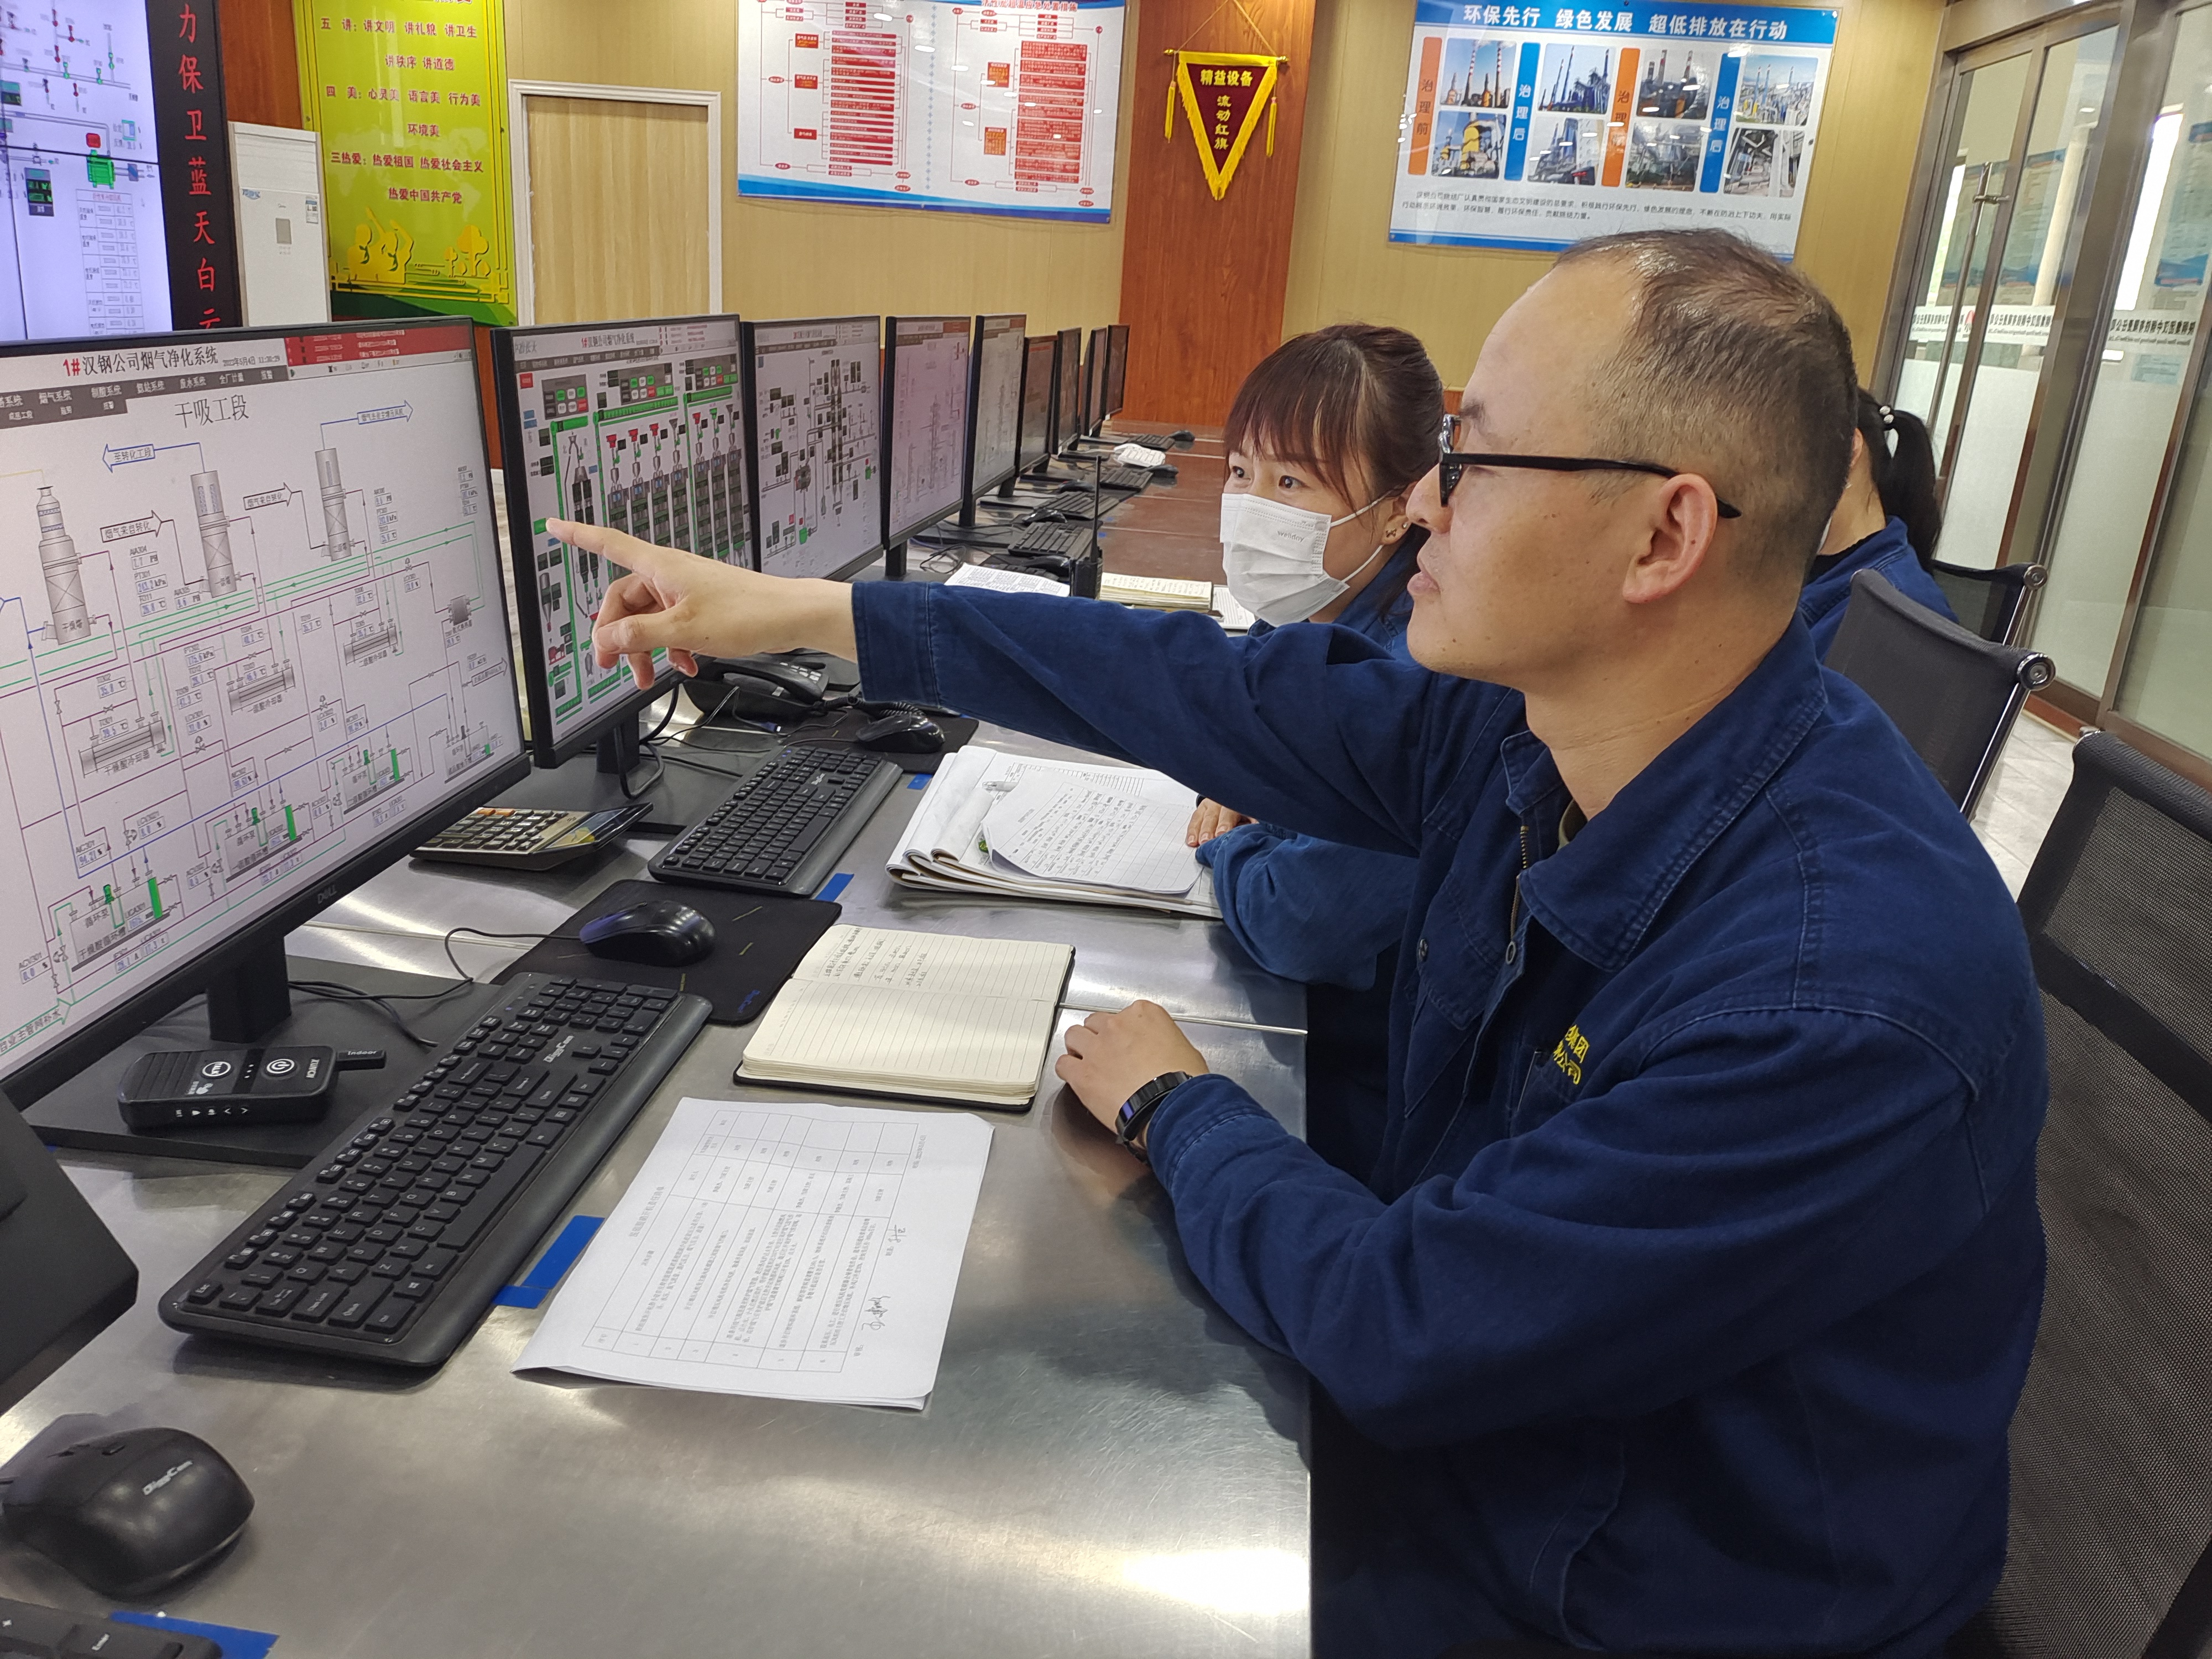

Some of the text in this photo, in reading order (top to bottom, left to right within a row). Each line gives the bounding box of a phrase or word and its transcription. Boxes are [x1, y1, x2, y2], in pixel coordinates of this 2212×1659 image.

[321, 18, 331, 29] 五
[404, 22, 437, 35] 讲礼貌
[445, 23, 478, 38] 讲卫生
[1463, 4, 1788, 40] 环保先行 绿色发展 超低排放在行动
[385, 54, 455, 70] 讲秩序 讲道德
[326, 86, 336, 97] 四
[409, 90, 440, 103] 语言美
[448, 92, 481, 106] 行为美
[1416, 79, 1433, 135] 治理前
[1512, 84, 1531, 141] 治理后
[408, 123, 440, 137] 环境美
[1708, 96, 1729, 153] 治理后
[420, 156, 484, 173] 热爱社会主义
[389, 187, 462, 204] 热爱中国共产党
[174, 394, 249, 429] 干吸工段
